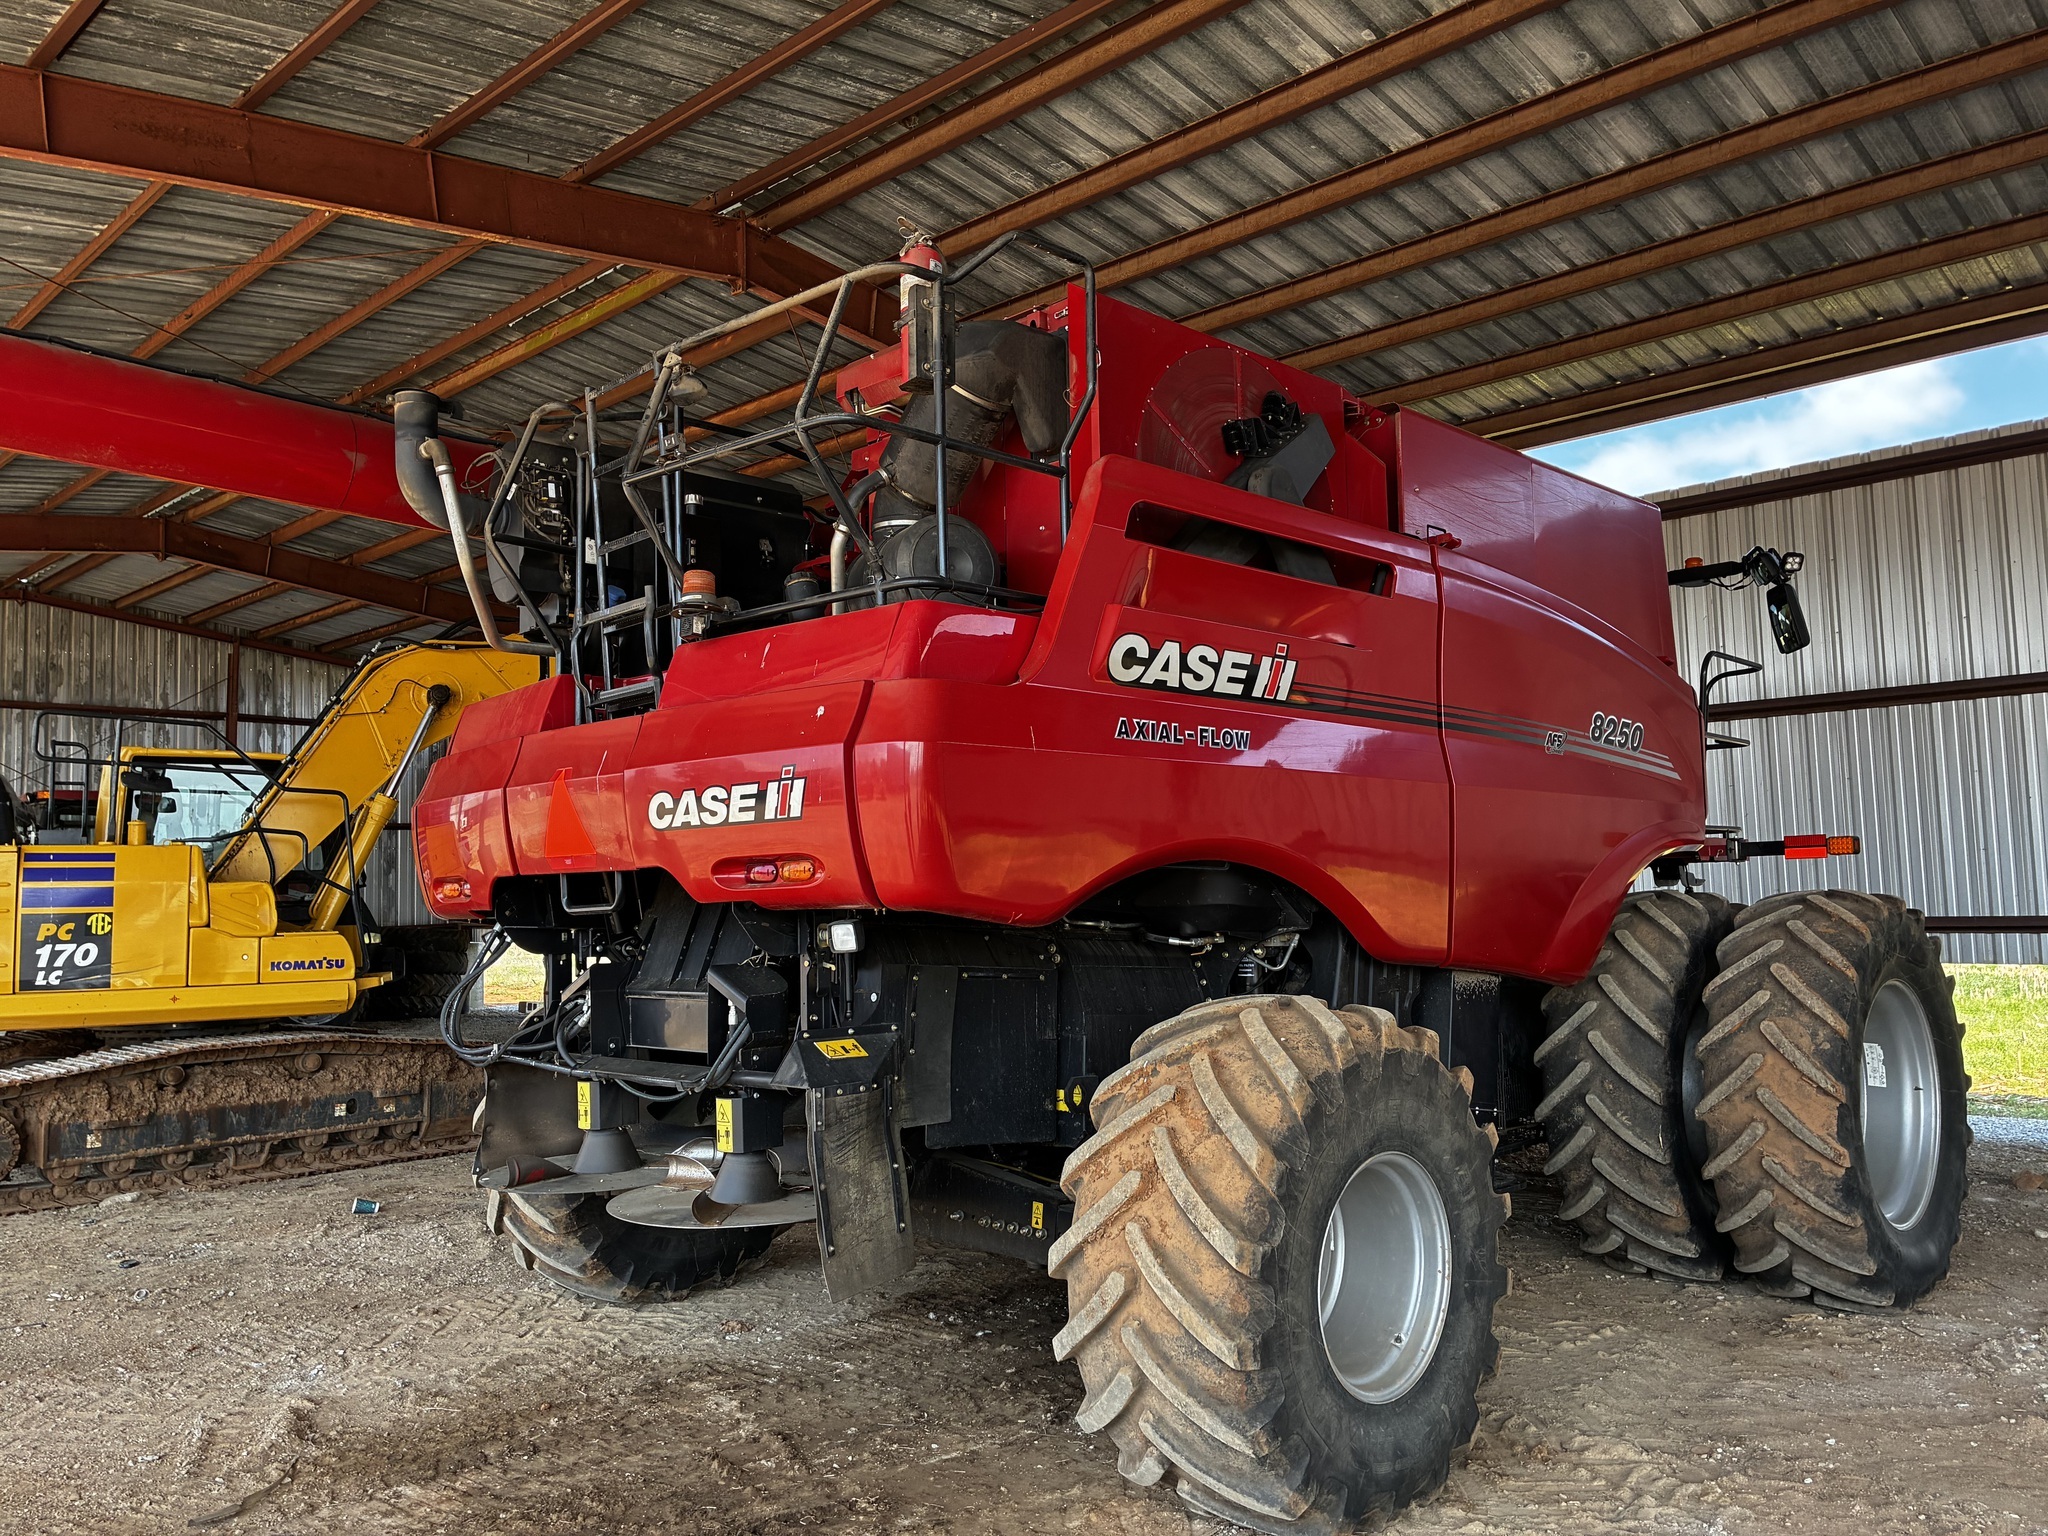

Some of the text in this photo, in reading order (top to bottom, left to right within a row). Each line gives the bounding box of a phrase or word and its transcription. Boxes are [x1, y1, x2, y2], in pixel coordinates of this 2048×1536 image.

[1108, 633, 1253, 696] CASE
[1114, 717, 1251, 752] AXIAL-FLOW
[1544, 731, 1566, 749] AFS
[1589, 711, 1645, 754] 8250
[648, 783, 759, 830] CASE
[36, 922, 76, 942] PC
[86, 912, 113, 936] TEC
[34, 942, 99, 968] 170
[270, 956, 346, 972] KOMATSU
[34, 969, 63, 986] LC
